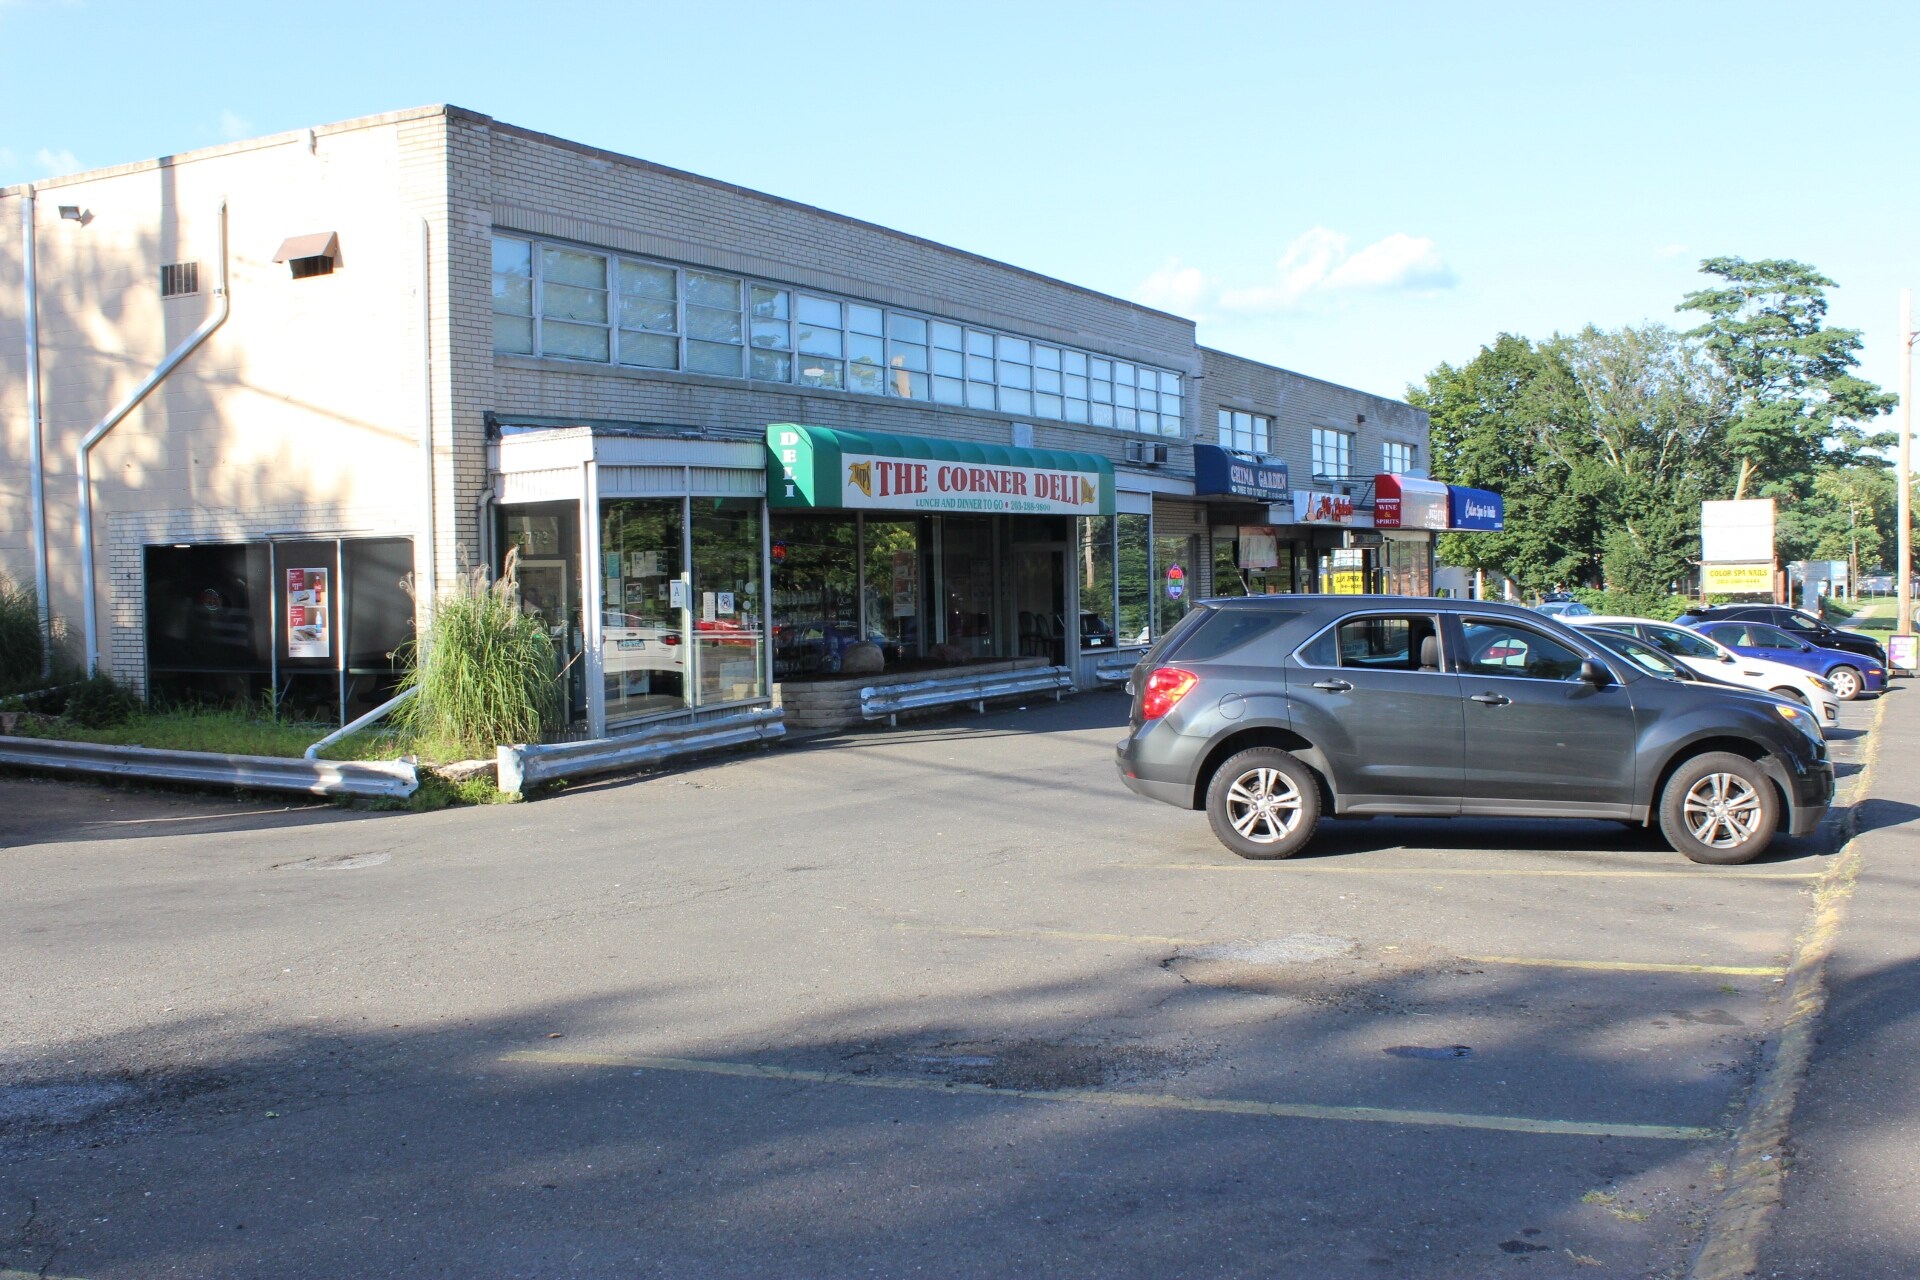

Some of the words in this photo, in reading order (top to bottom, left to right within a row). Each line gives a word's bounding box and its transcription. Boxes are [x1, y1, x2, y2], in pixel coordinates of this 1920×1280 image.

[780, 432, 799, 498] DELI
[876, 461, 929, 497] THE
[937, 465, 1028, 496] CORNER
[1033, 473, 1080, 506] DELI
[1231, 464, 1255, 487] CHINA
[1258, 470, 1287, 490] GARDEN
[915, 498, 940, 508] LUNCH
[941, 498, 956, 508] AND
[956, 498, 982, 510] DINNER
[983, 499, 993, 510] TO
[993, 499, 1004, 511] GO
[1376, 518, 1400, 526] SPIRITS
[1710, 569, 1732, 577] COLOR
